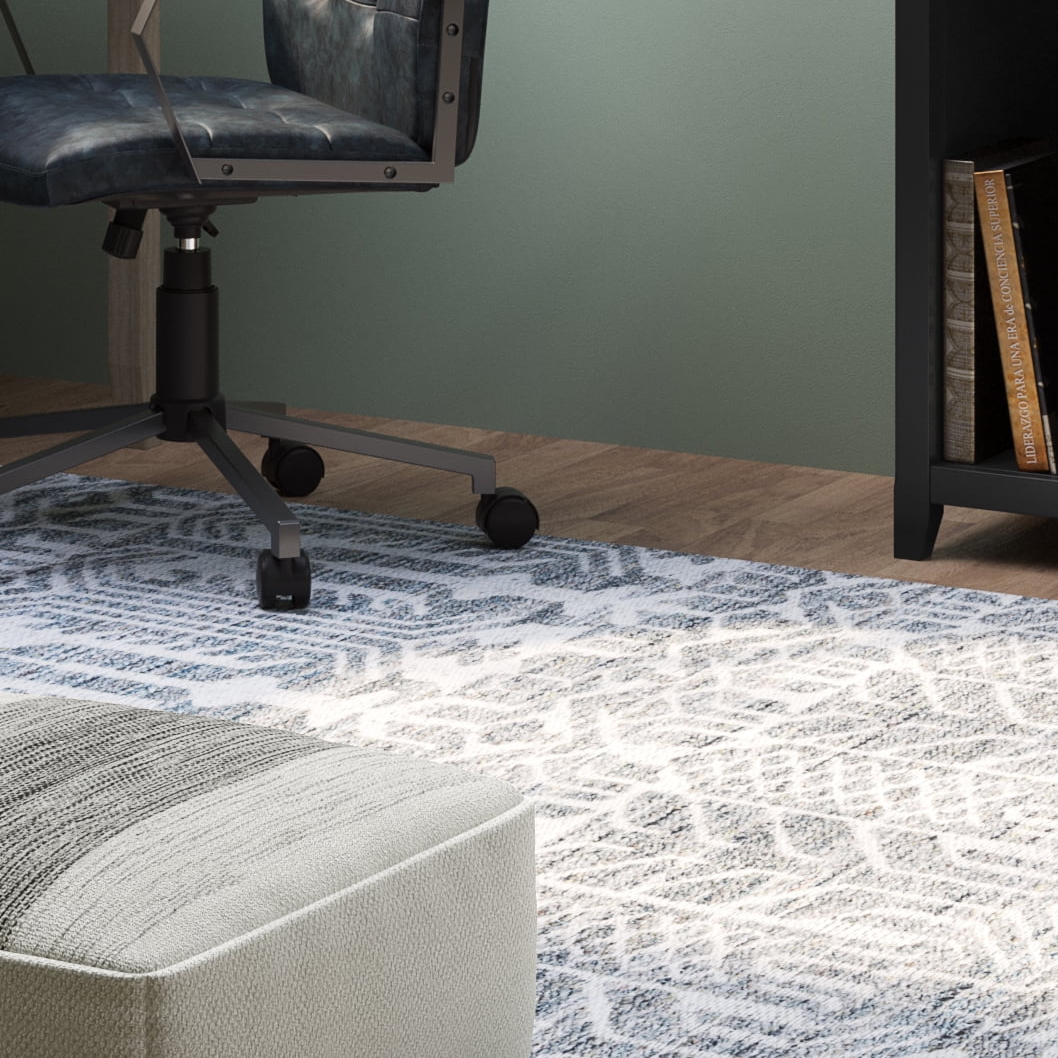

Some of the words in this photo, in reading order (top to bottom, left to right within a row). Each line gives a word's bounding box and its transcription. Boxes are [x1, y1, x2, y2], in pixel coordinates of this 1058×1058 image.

[984, 179, 1001, 232] SUPERIOR
[991, 233, 1012, 303] CONCIENCIA
[1004, 304, 1014, 315] de
[1006, 317, 1018, 340] ERA
[1010, 342, 1023, 367] UNA
[1013, 369, 1028, 399] PARA
[1018, 401, 1037, 464] LIDERAZGO
